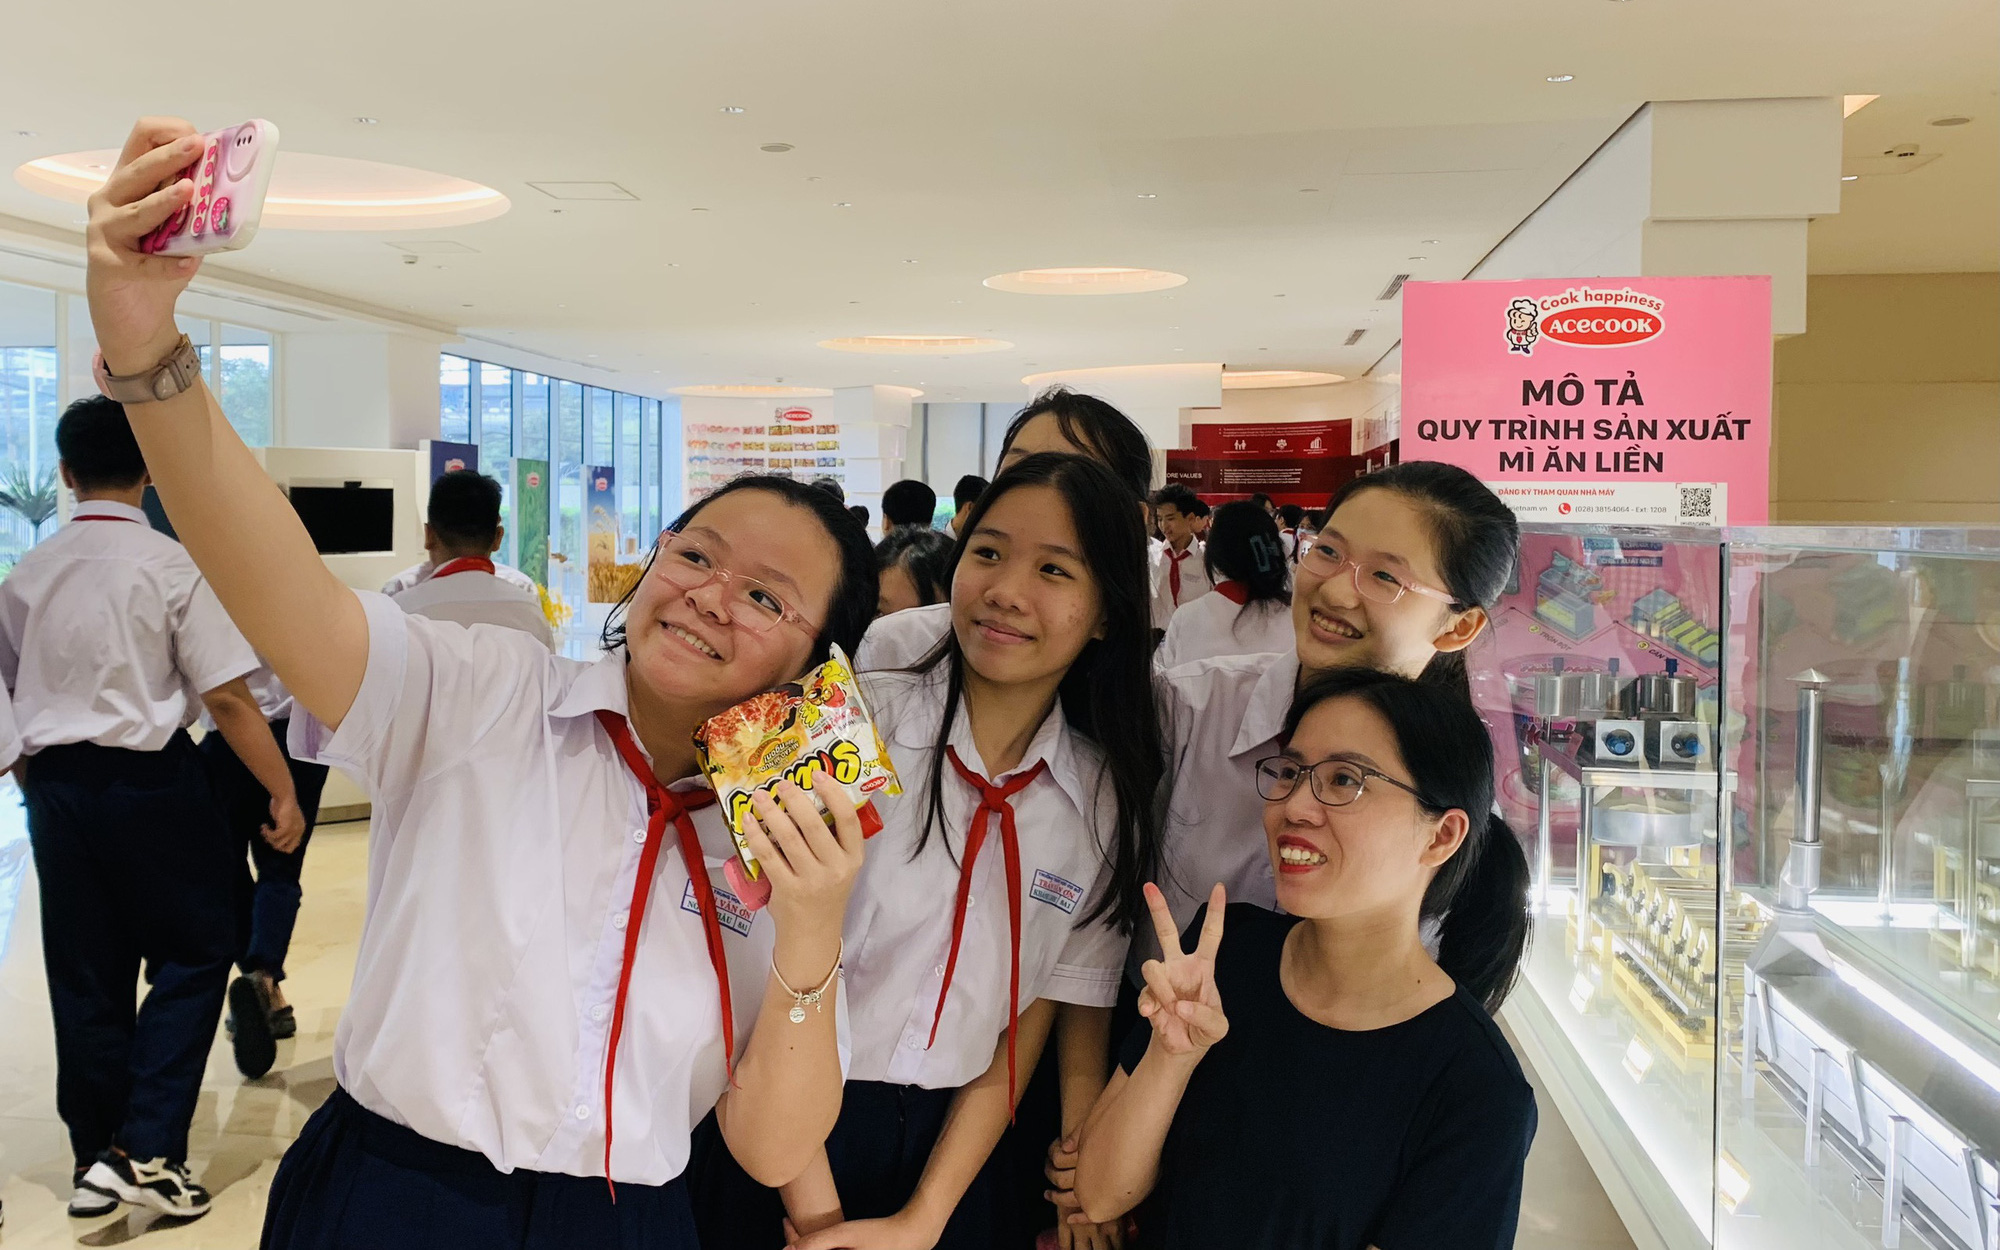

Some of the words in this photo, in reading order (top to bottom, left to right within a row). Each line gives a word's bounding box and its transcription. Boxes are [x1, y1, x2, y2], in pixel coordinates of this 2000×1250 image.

[1541, 292, 1579, 311] Cook
[1584, 290, 1662, 311] happiness
[1522, 372, 1585, 406] MÔ
[1594, 370, 1644, 406] TẢ
[1417, 419, 1482, 441] QUY
[1489, 415, 1584, 440] TRÌNH
[1593, 413, 1658, 441] SẢN
[1665, 411, 1751, 441] XUẤT
[1500, 446, 1534, 472] MÌ
[1542, 446, 1587, 472] ĂN
[1596, 444, 1664, 473] LIỀN
[1498, 488, 1520, 496] ĐĂNG
[1521, 488, 1532, 496] KÝ
[1557, 489, 1580, 497] QUAN
[1581, 488, 1597, 496] NHÀ
[1599, 488, 1615, 496] MÁY
[1575, 505, 1594, 513] (028)
[719, 899, 739, 913] VĂN
